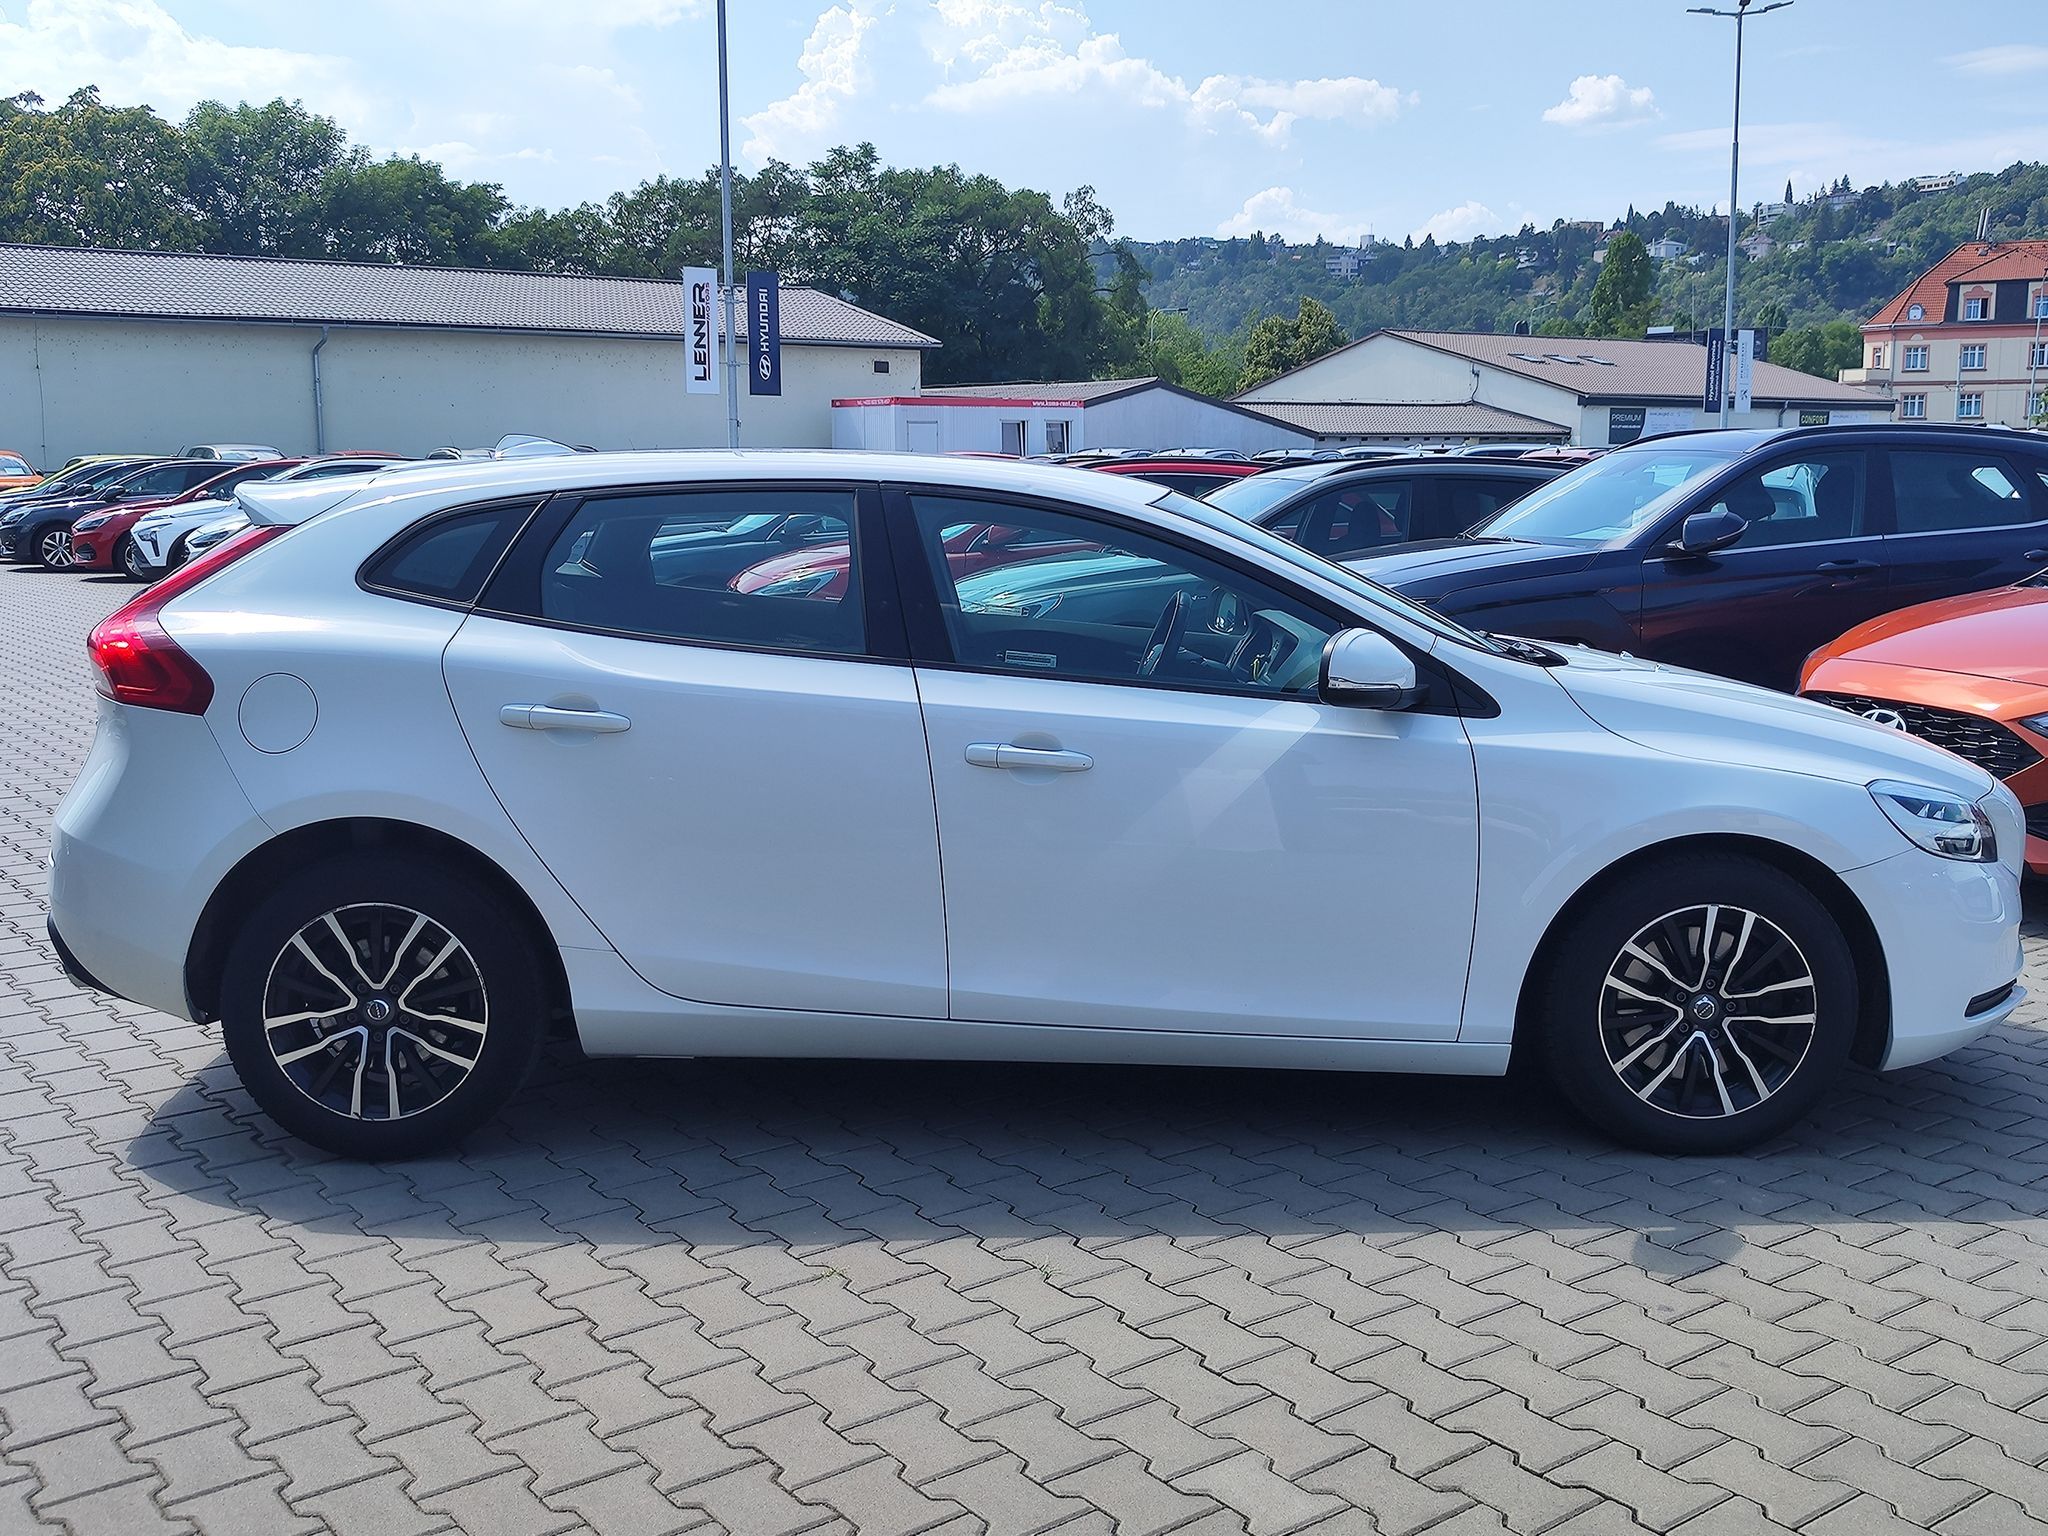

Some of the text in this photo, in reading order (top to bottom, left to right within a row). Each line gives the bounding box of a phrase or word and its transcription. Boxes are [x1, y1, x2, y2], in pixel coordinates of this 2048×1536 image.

[693, 282, 707, 381] LENNER
[759, 288, 769, 352] HYUNDAI
[1611, 414, 1641, 422] PREMIUM
